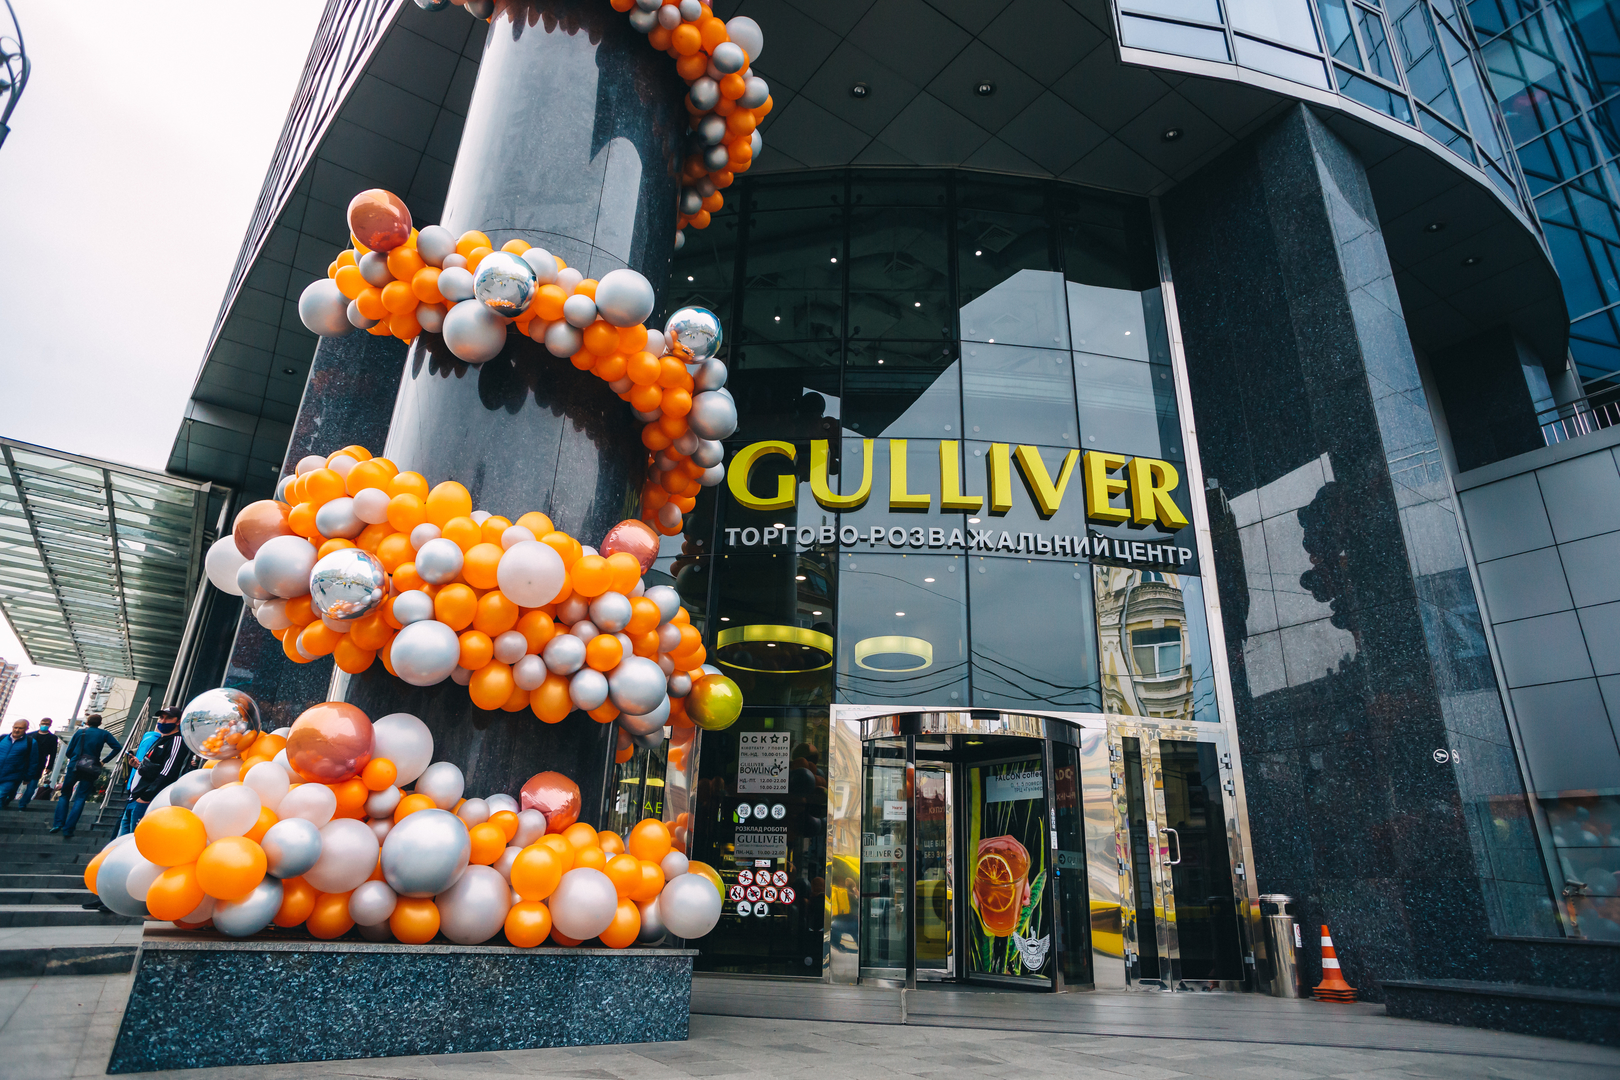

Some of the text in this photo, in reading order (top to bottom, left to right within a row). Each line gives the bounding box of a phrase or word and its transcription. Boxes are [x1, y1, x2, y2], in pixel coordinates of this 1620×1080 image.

[727, 438, 1189, 529] GULLIVER
[725, 525, 1193, 565] ТОРГОВО-РОЗВАЖАЛЬНИЙ ЦЕНТР
[740, 766, 779, 777] BOWLING
[996, 772, 1020, 782] FALCON
[737, 834, 784, 844] GULLIVER
